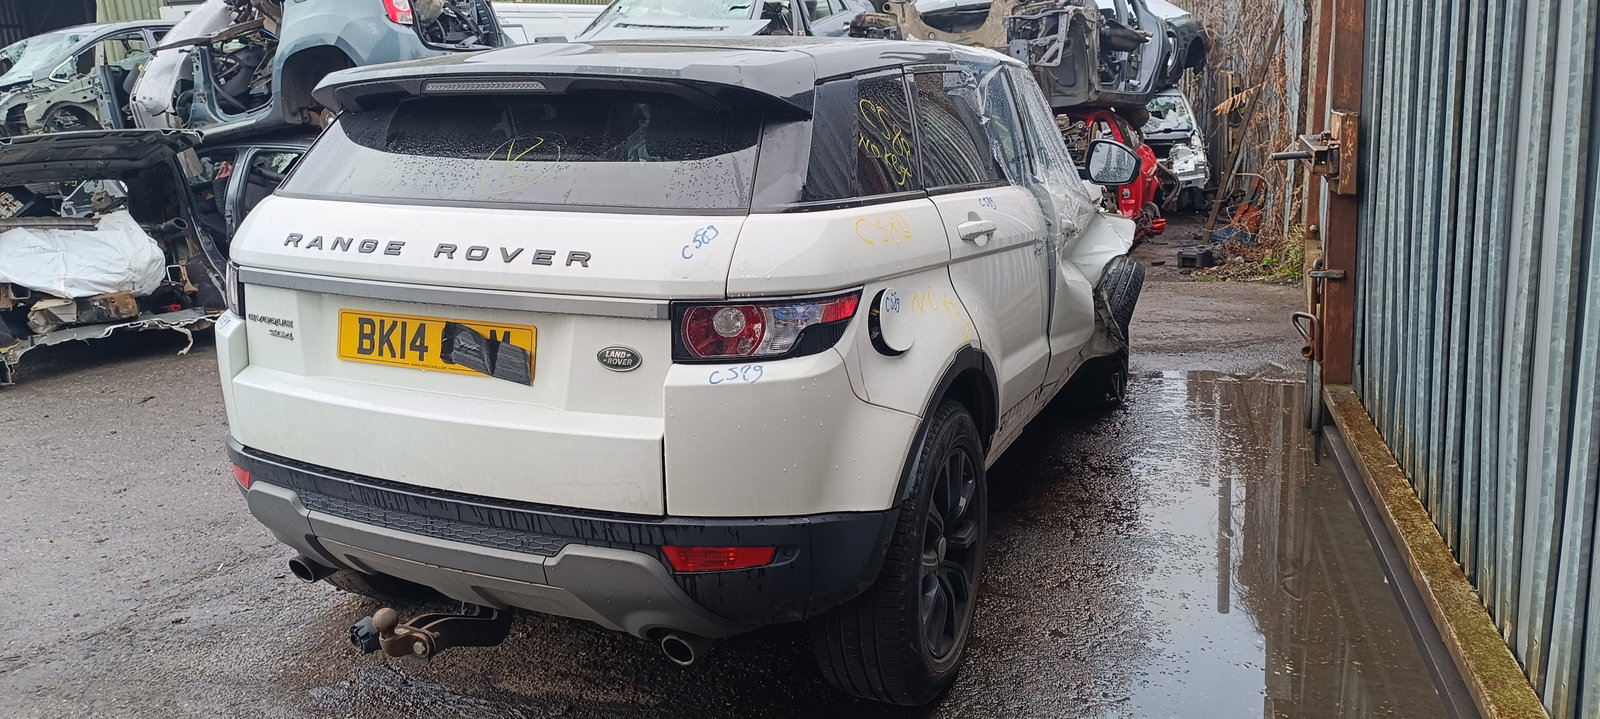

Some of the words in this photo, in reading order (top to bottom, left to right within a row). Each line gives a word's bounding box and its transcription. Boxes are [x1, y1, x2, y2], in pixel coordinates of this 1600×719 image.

[284, 232, 406, 255] RANGE
[433, 243, 592, 268] ROVER
[357, 316, 428, 362] BK14
[605, 350, 627, 358] LAND
